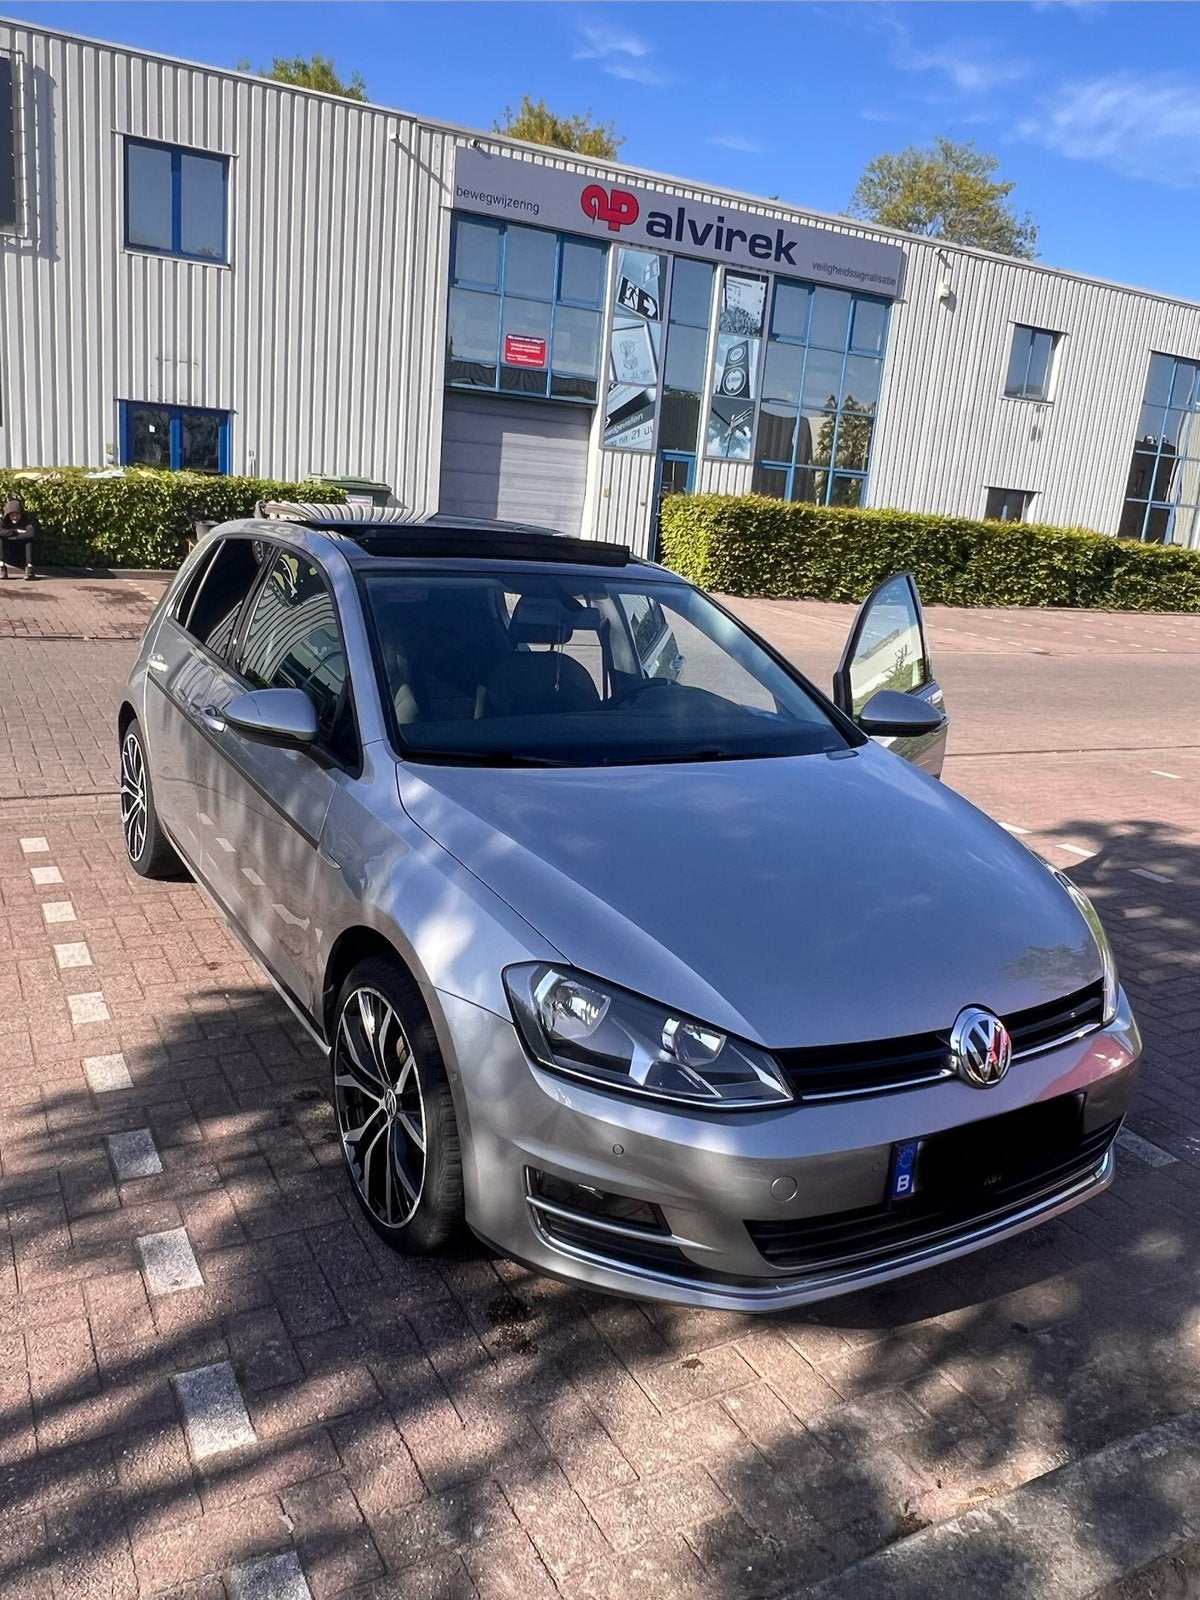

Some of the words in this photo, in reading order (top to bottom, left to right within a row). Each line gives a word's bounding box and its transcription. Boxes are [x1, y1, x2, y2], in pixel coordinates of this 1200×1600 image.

[456, 185, 540, 215] bewegwijzering
[646, 207, 798, 266] alvirek
[812, 261, 897, 287] veiligheidssignalisatie
[896, 1174, 911, 1193] B
